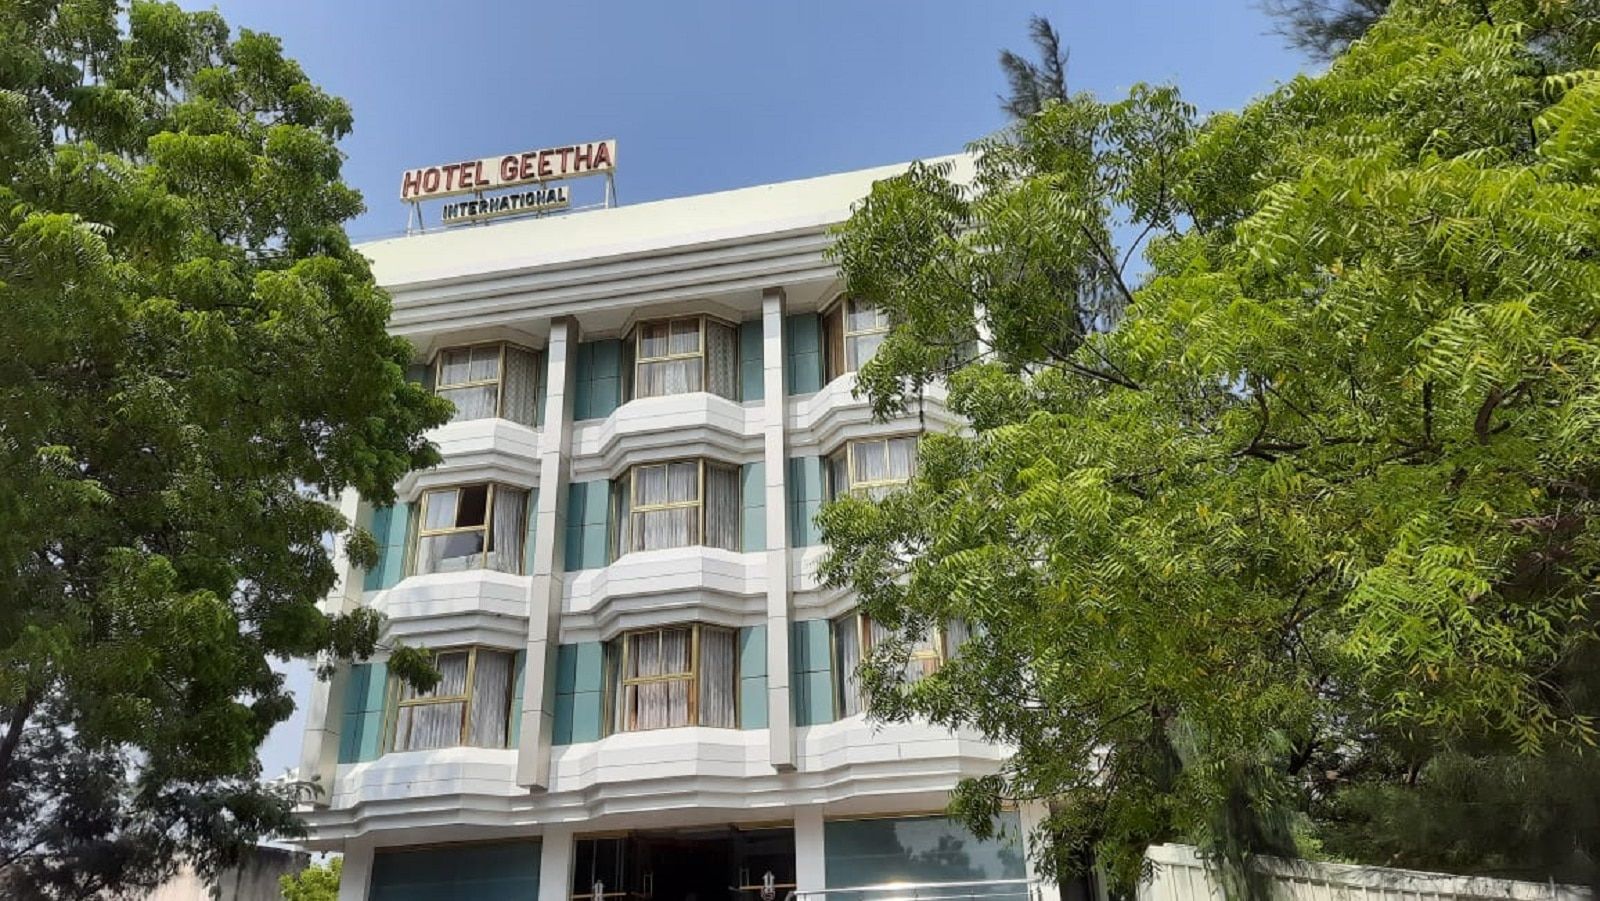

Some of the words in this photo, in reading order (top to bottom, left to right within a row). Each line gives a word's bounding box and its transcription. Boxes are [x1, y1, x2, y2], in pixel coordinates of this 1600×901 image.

[402, 160, 489, 197] HOTEL
[500, 142, 612, 181] GEETHA
[443, 188, 566, 219] INTERNATIONAL
